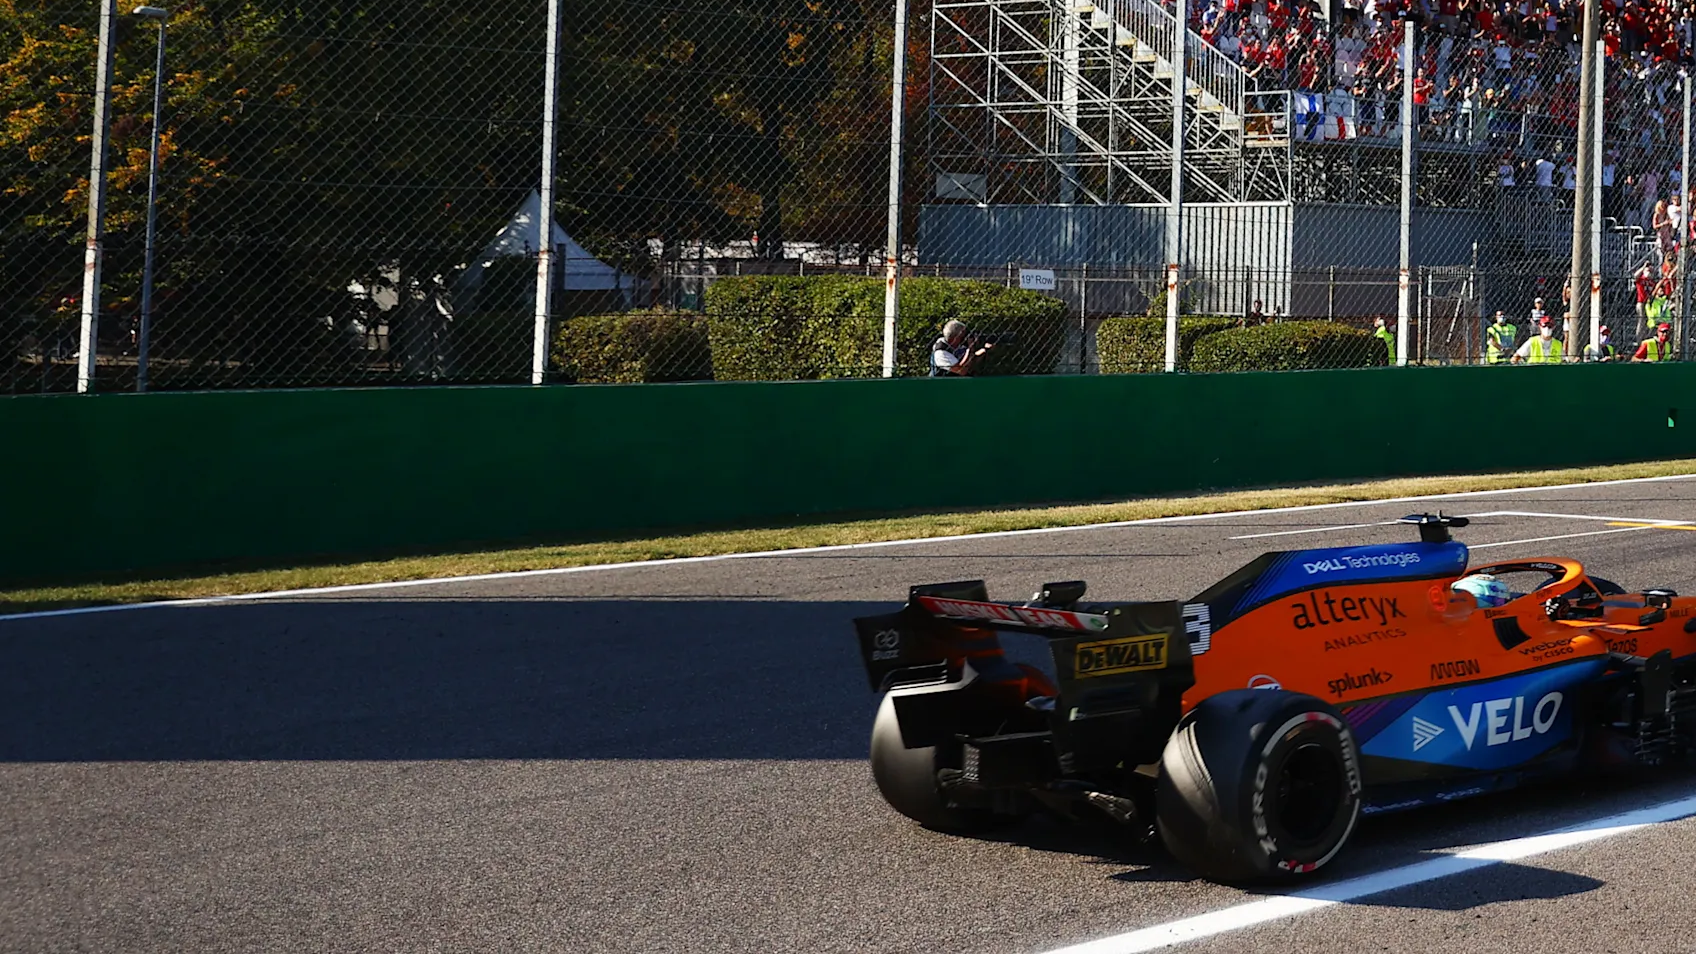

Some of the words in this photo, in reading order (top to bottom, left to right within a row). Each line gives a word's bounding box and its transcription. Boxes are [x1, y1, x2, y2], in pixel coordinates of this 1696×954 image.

[1035, 274, 1053, 285] Row
[1303, 558, 1346, 574] DELL
[1342, 552, 1420, 568] Technologies
[1291, 592, 1407, 630] alteryx
[1324, 628, 1407, 652] ANALYTICS
[1519, 637, 1577, 655] webex
[1430, 659, 1481, 681] ARROW
[1447, 691, 1563, 750] VELO
